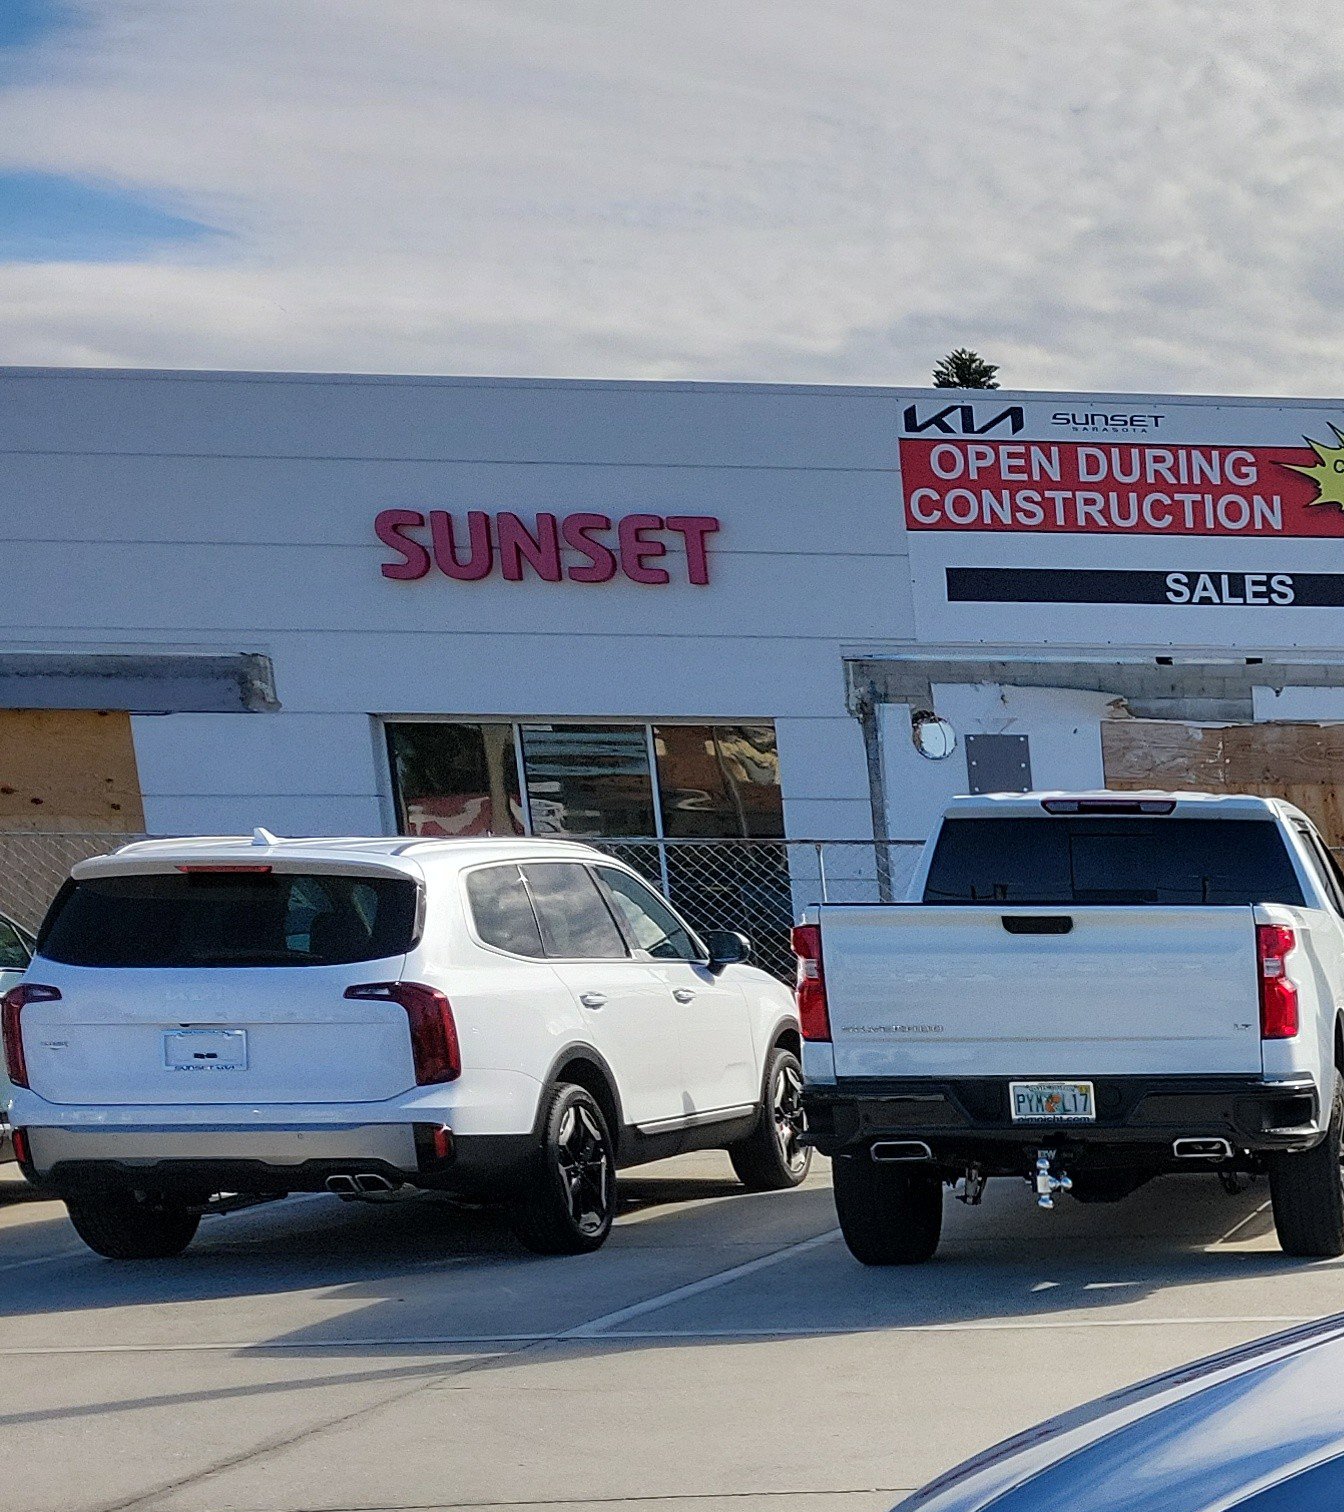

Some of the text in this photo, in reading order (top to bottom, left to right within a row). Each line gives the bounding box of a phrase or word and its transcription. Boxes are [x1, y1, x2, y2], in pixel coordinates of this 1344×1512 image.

[903, 404, 1024, 435] KIA
[1051, 413, 1165, 428] SUNSET
[929, 443, 1257, 487] OPEN DURING
[910, 487, 1283, 531] CONSTRUCTION
[374, 509, 720, 585] SUNSET
[1165, 573, 1296, 605] SALES
